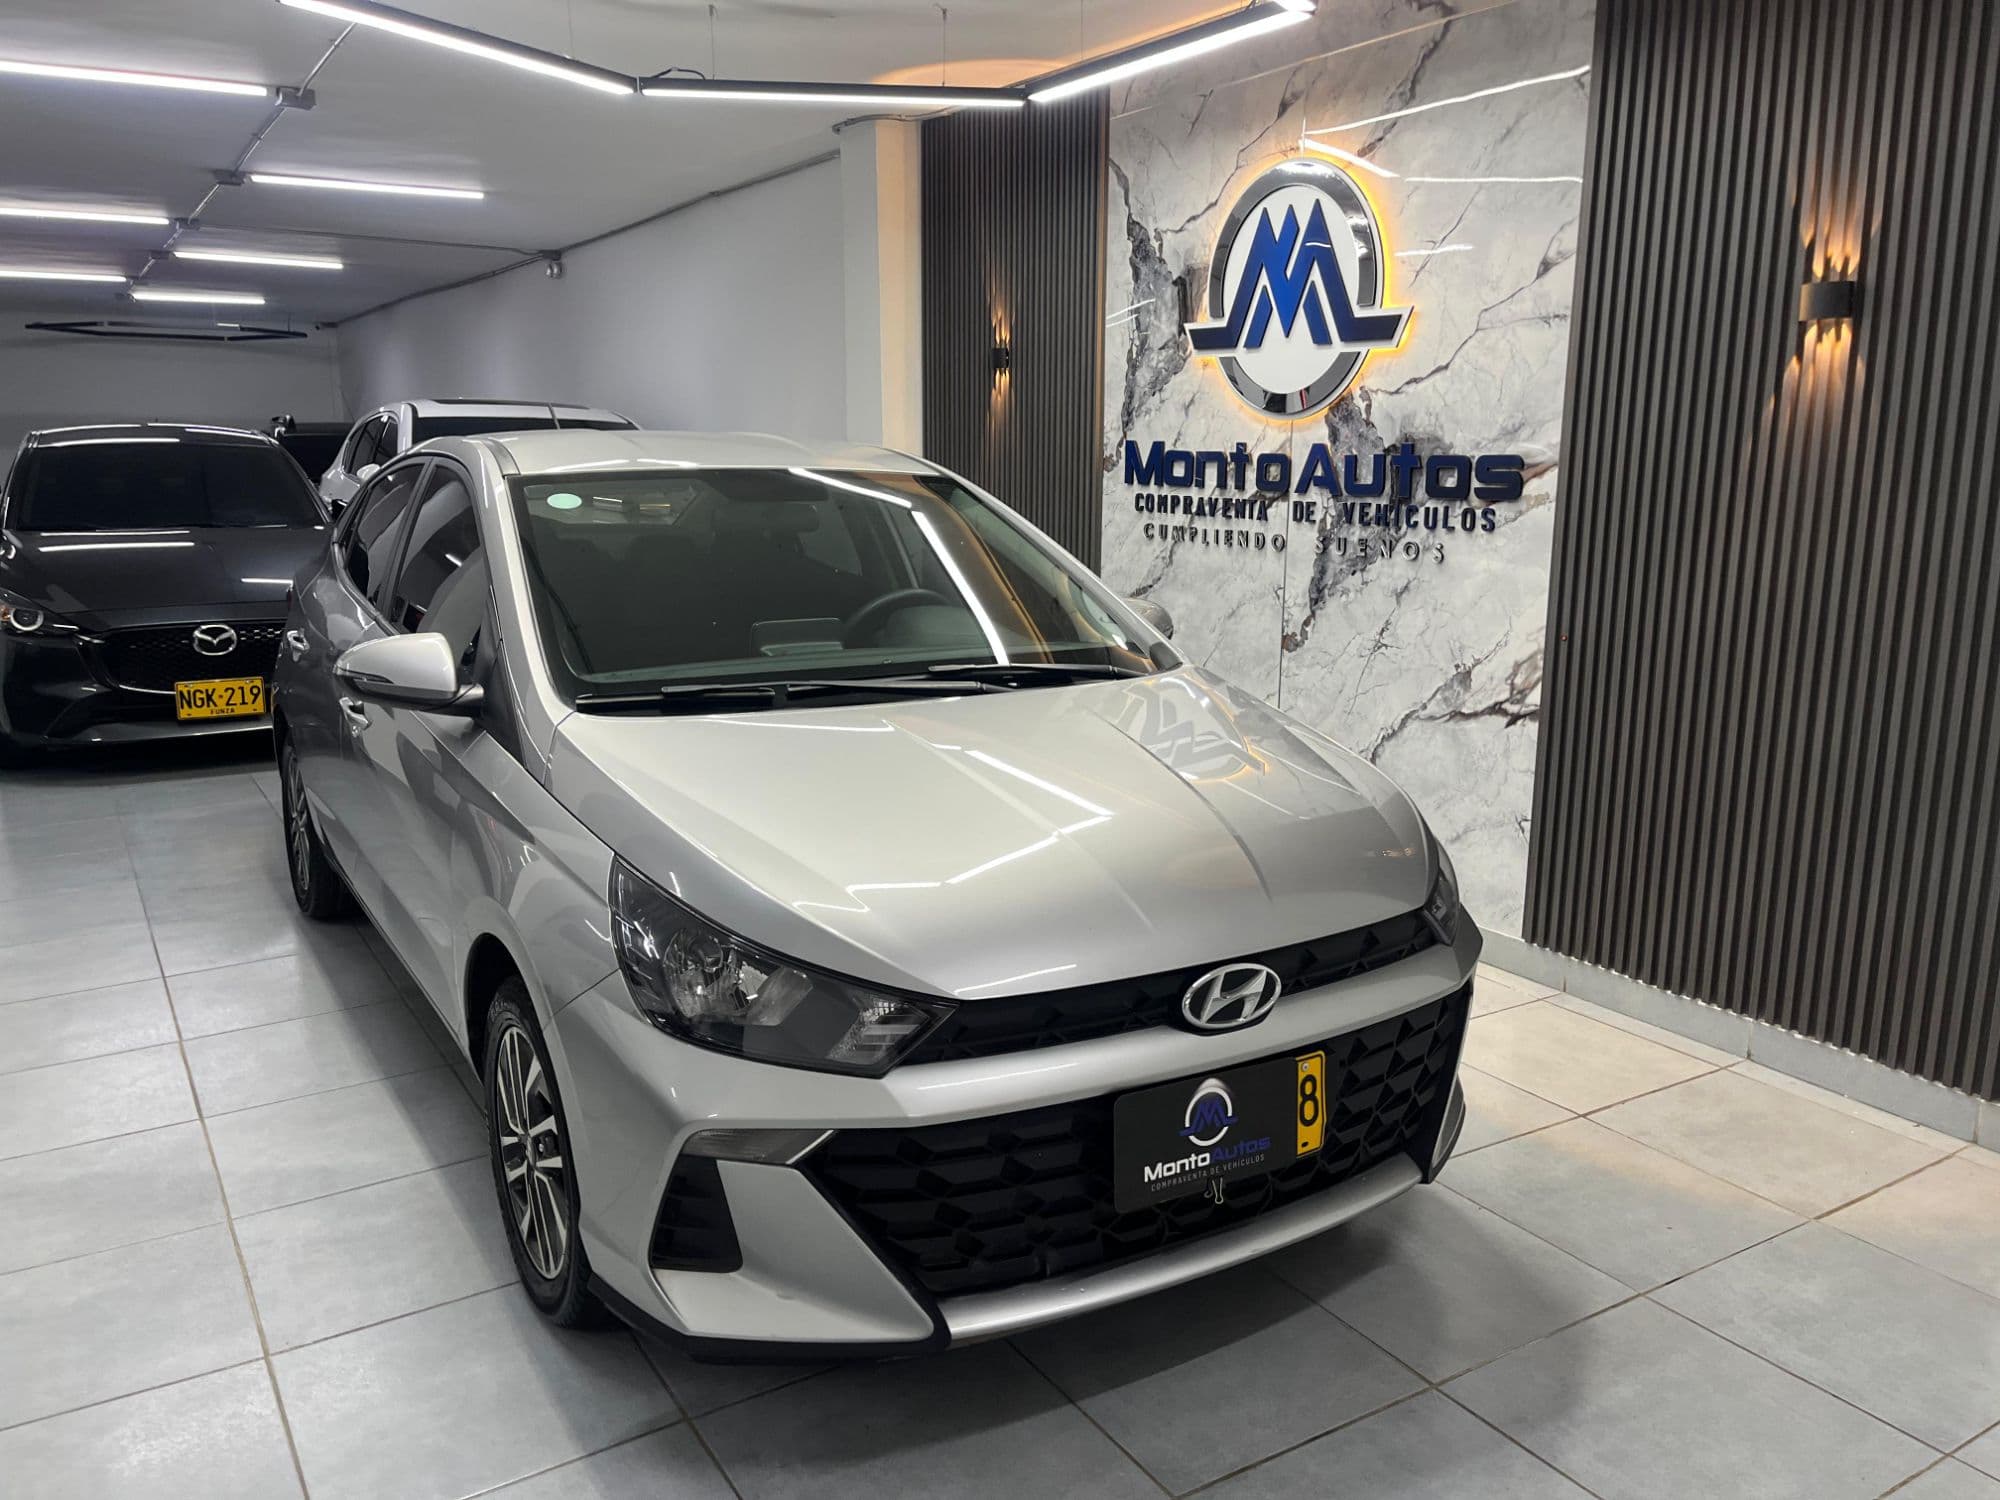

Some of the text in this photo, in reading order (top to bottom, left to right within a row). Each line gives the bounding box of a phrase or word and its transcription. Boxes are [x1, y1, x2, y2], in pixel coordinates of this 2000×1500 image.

[1135, 493, 1269, 522] COMPRAVENTA
[1292, 500, 1317, 523] DE
[1143, 522, 1286, 553] CUMPLIENDO
[1299, 1073, 1319, 1127] 8
[1151, 1170, 1208, 1193] COMPRAVENTA
[1210, 1166, 1220, 1177] DE
